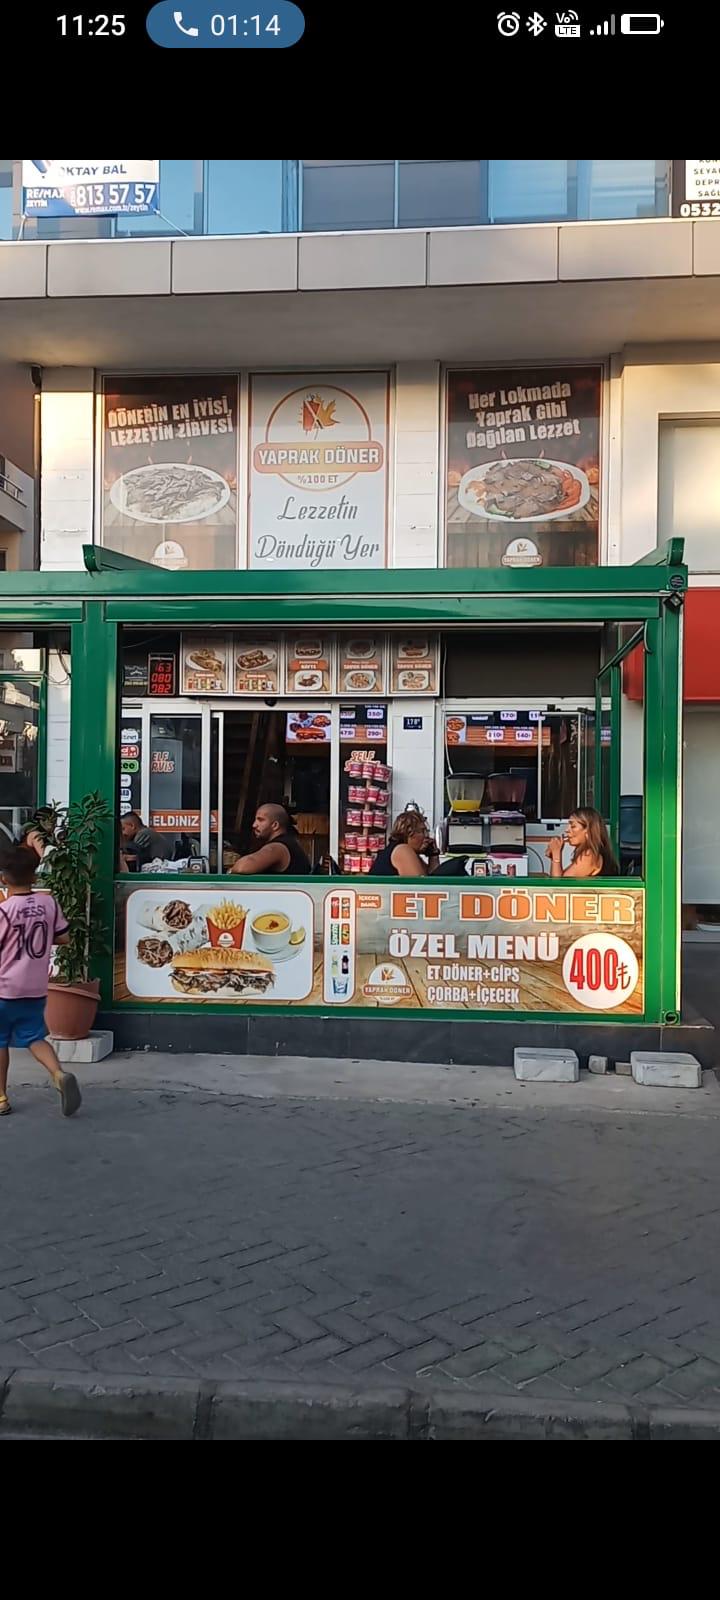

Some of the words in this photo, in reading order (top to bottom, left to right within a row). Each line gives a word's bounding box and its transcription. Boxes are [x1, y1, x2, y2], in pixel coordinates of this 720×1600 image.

[103, 164, 128, 175] BAL
[26, 188, 64, 200] RE/MAX
[76, 184, 104, 207] 813
[109, 183, 130, 205] 57
[134, 183, 156, 204] 57
[680, 202, 720, 218] 0532
[468, 391, 497, 410] Her
[500, 381, 572, 405] Lokmada
[172, 405, 190, 421] EN
[476, 406, 532, 428] Yaprak
[536, 400, 568, 421] Gibi
[110, 421, 174, 447] LEZZETİN
[176, 416, 234, 440] ZİRVESİ
[466, 428, 526, 450] Dağılan
[529, 418, 581, 440] Lezzet
[258, 448, 320, 466] YAPRAK
[324, 445, 380, 464] DÖNER
[297, 474, 326, 485] %100
[328, 474, 339, 484] ET
[277, 494, 359, 521] Lezzetin
[254, 534, 336, 568] Döndüğü
[337, 533, 380, 560] Yer
[151, 673, 172, 683] 080
[350, 750, 375, 761] SELF
[150, 815, 200, 827] ELDİNİZ
[17, 905, 46, 919] MESSI
[390, 890, 448, 921] ET
[459, 888, 636, 925] DÖNER
[13, 920, 48, 960] 10
[388, 928, 461, 960] ÖZEL
[467, 930, 560, 961] MENÜ
[426, 964, 442, 980] ET
[443, 962, 521, 982] DÖNER+CİPS
[426, 984, 521, 1005] ÇORBA+İÇECEK
